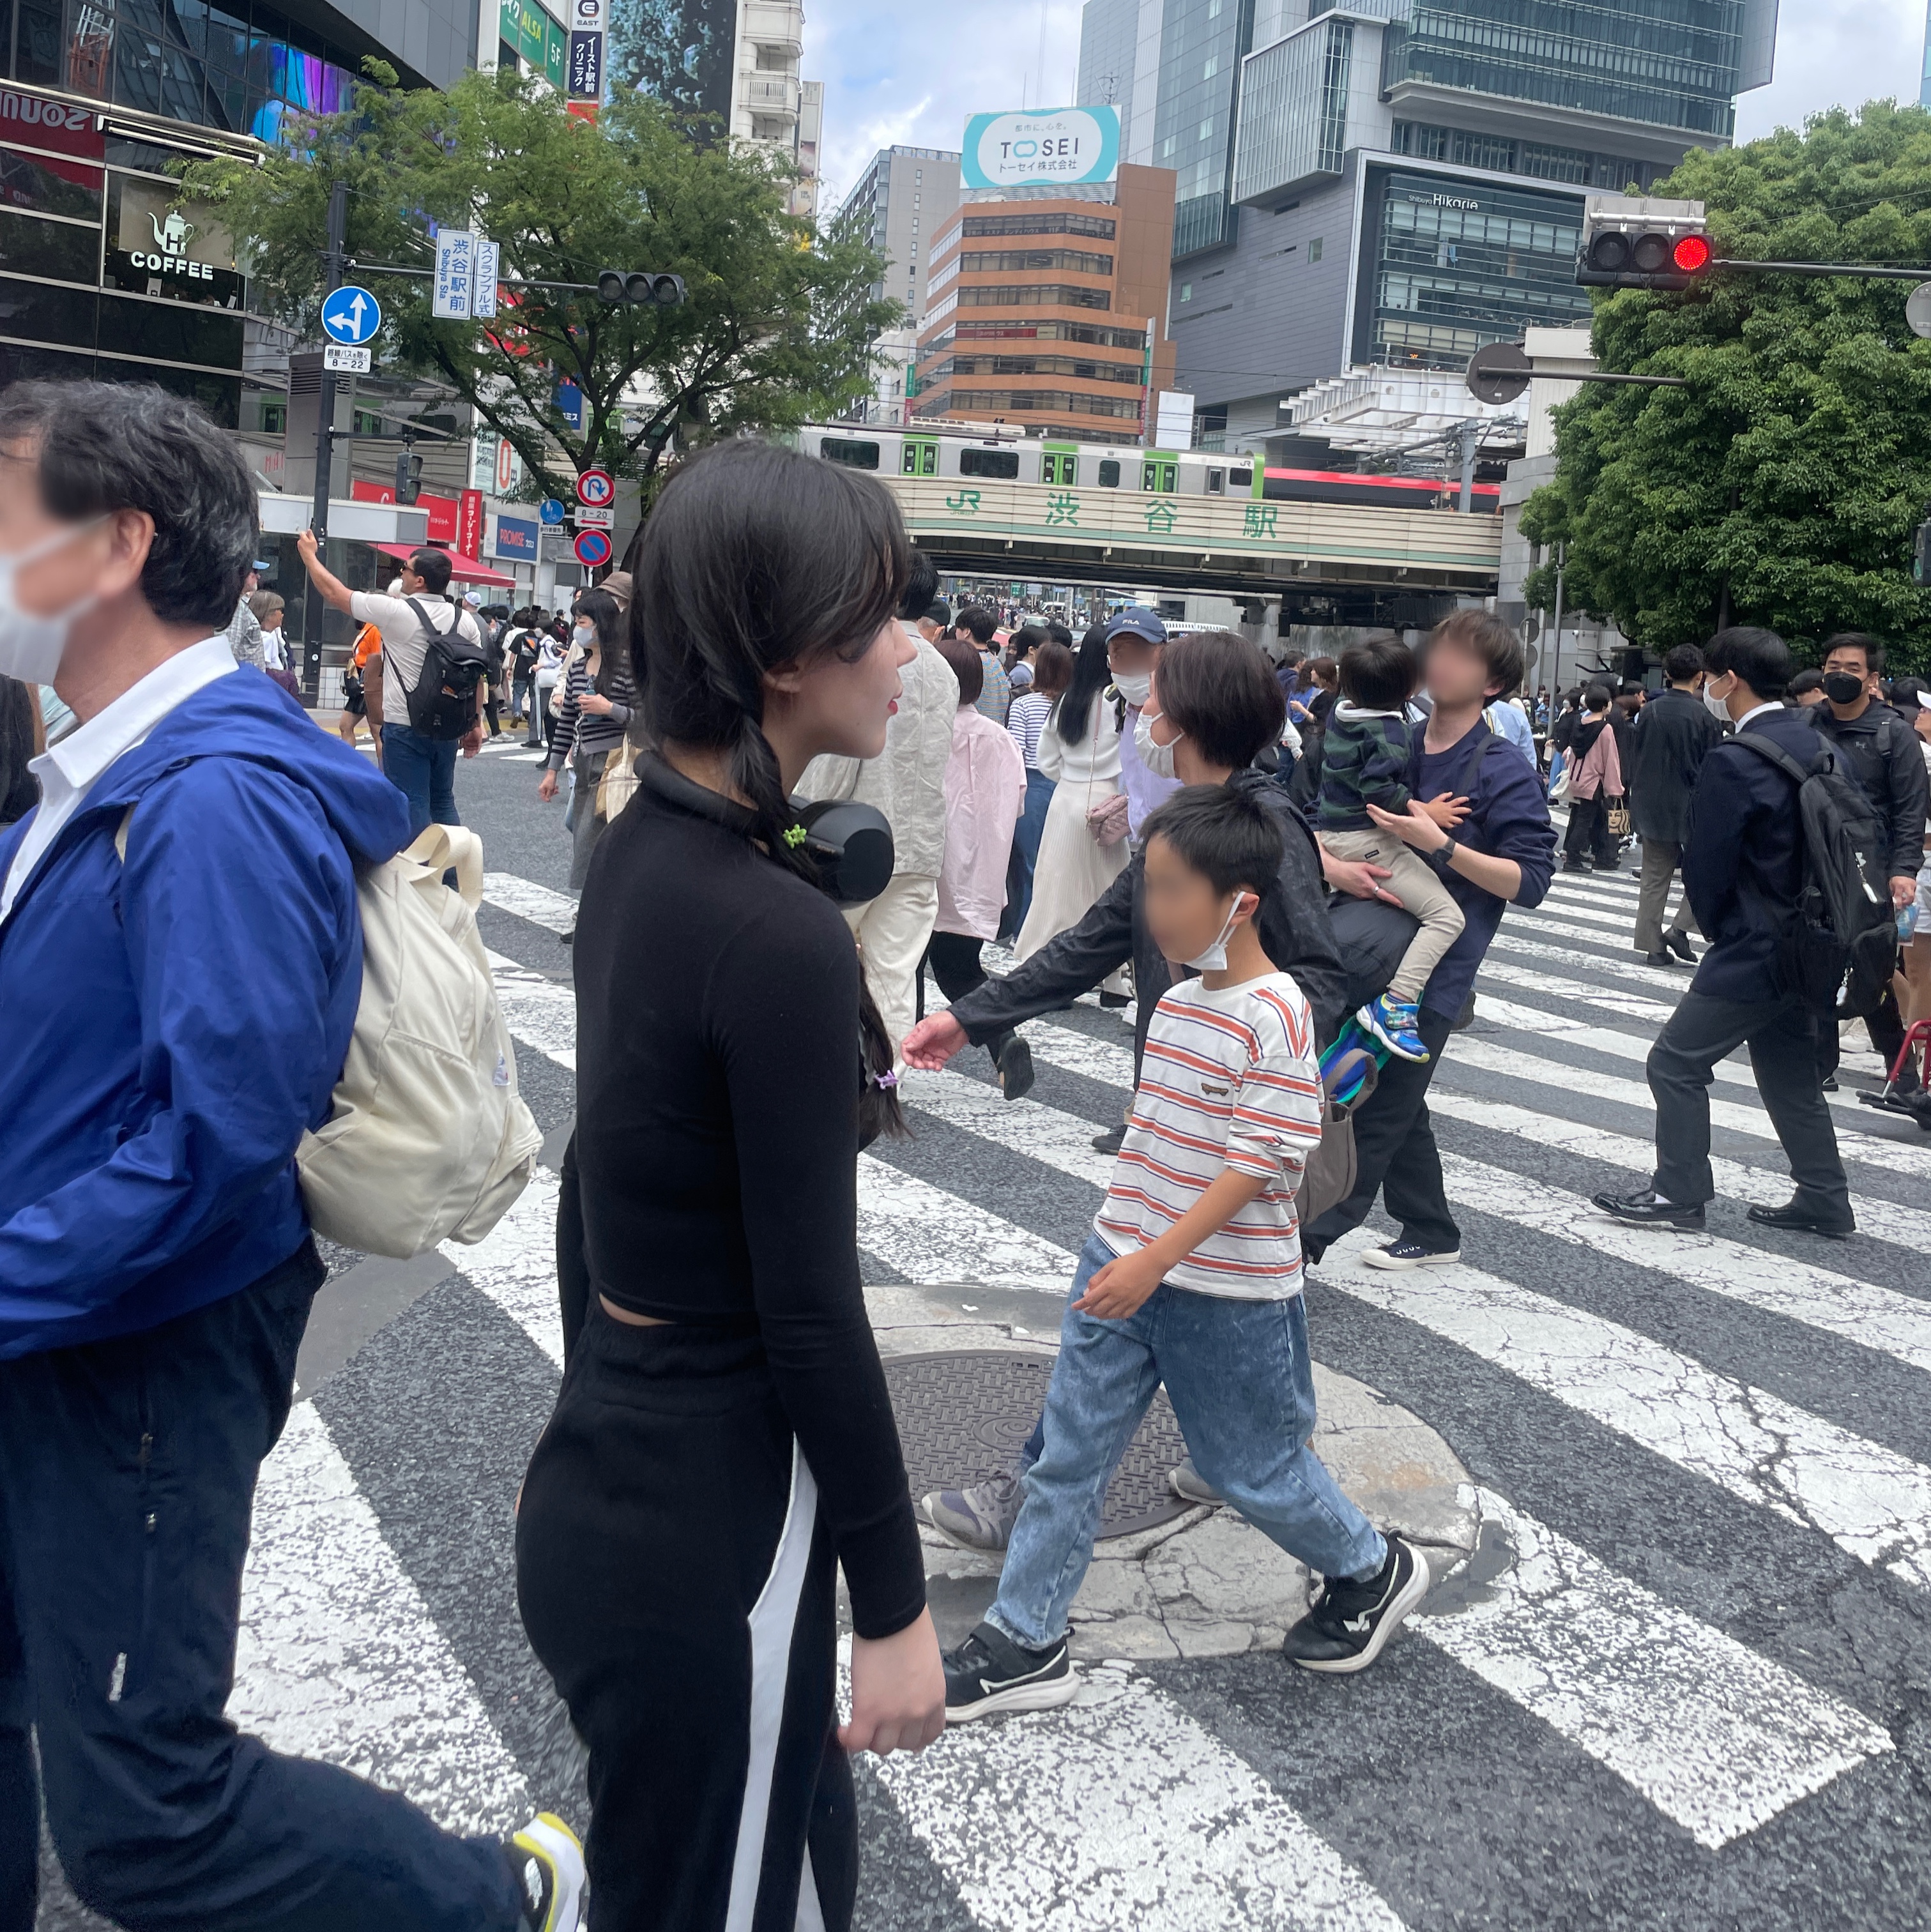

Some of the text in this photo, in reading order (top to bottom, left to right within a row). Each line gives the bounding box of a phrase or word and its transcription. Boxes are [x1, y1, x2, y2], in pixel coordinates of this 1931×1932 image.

[501, 0, 520, 19] イク
[521, 10, 542, 43] ALSA
[551, 42, 561, 66] 5F
[574, 43, 585, 87] クリニック
[584, 36, 596, 93] イースト駅前
[1000, 137, 1079, 159] TOSEI
[999, 159, 1078, 173] トーセイ株式会社
[1408, 194, 1479, 210] Shibuya Hikarie
[130, 251, 214, 281] COFFEE
[439, 248, 451, 301] Shibuya Sta.
[449, 239, 469, 312] 渋谷駅前
[946, 490, 981, 510] JR
[465, 496, 476, 556] コージーコーナー
[500, 528, 525, 547] PROMISE
